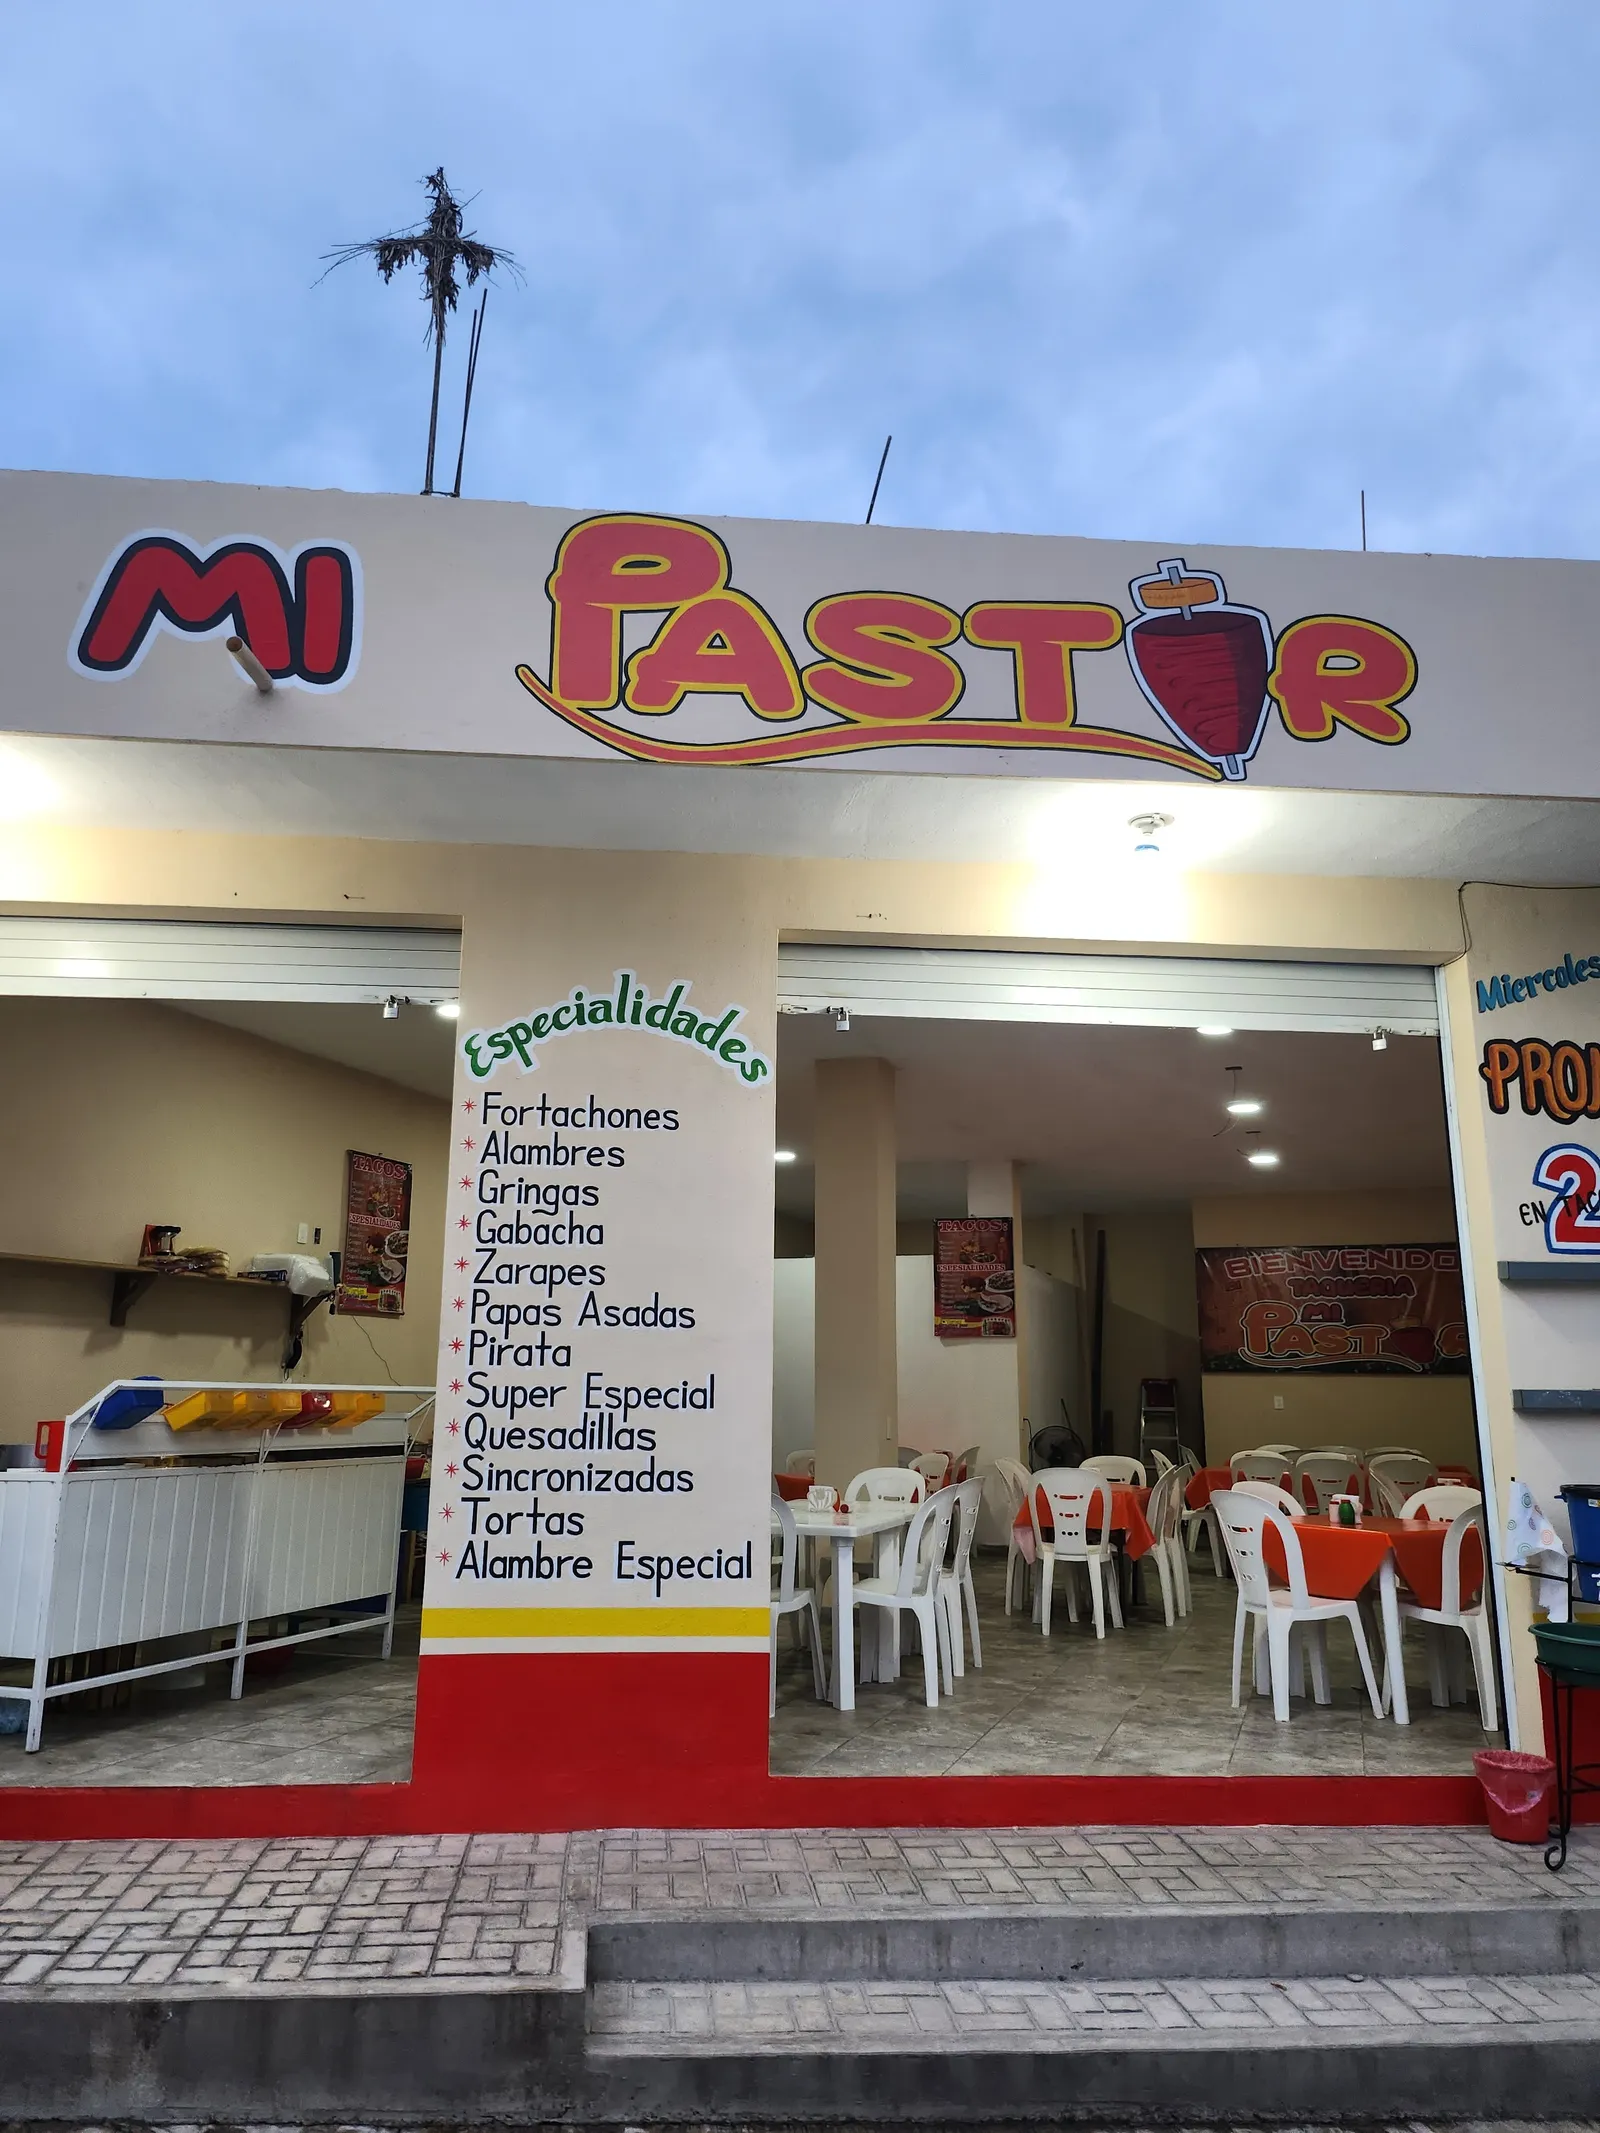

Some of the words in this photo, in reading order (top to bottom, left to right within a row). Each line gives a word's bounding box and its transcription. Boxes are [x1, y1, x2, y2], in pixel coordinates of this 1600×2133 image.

[76, 534, 356, 686] MI
[464, 973, 768, 1083] Especialidades
[483, 1092, 679, 1130] Fortachones
[480, 1131, 624, 1167] Alambres
[479, 1169, 599, 1216] Gringas
[1519, 1200, 1547, 1227] EN
[1557, 1189, 1600, 1218] TAC
[477, 1208, 603, 1245] Gabacha
[473, 1248, 605, 1299] Zarapes
[1286, 1275, 1418, 1300] TAQUERIA
[471, 1287, 561, 1340] Papas
[578, 1291, 695, 1328] Asadas
[1300, 1302, 1346, 1324] MI
[469, 1328, 571, 1365] Pirata
[467, 1372, 567, 1420] Super
[584, 1373, 714, 1422] Especial
[465, 1411, 656, 1452] Quesadillas
[462, 1454, 693, 1492] Sincronizadas
[461, 1497, 584, 1535] Tortas
[456, 1541, 592, 1579] Alambre
[617, 1541, 751, 1597] Especial
